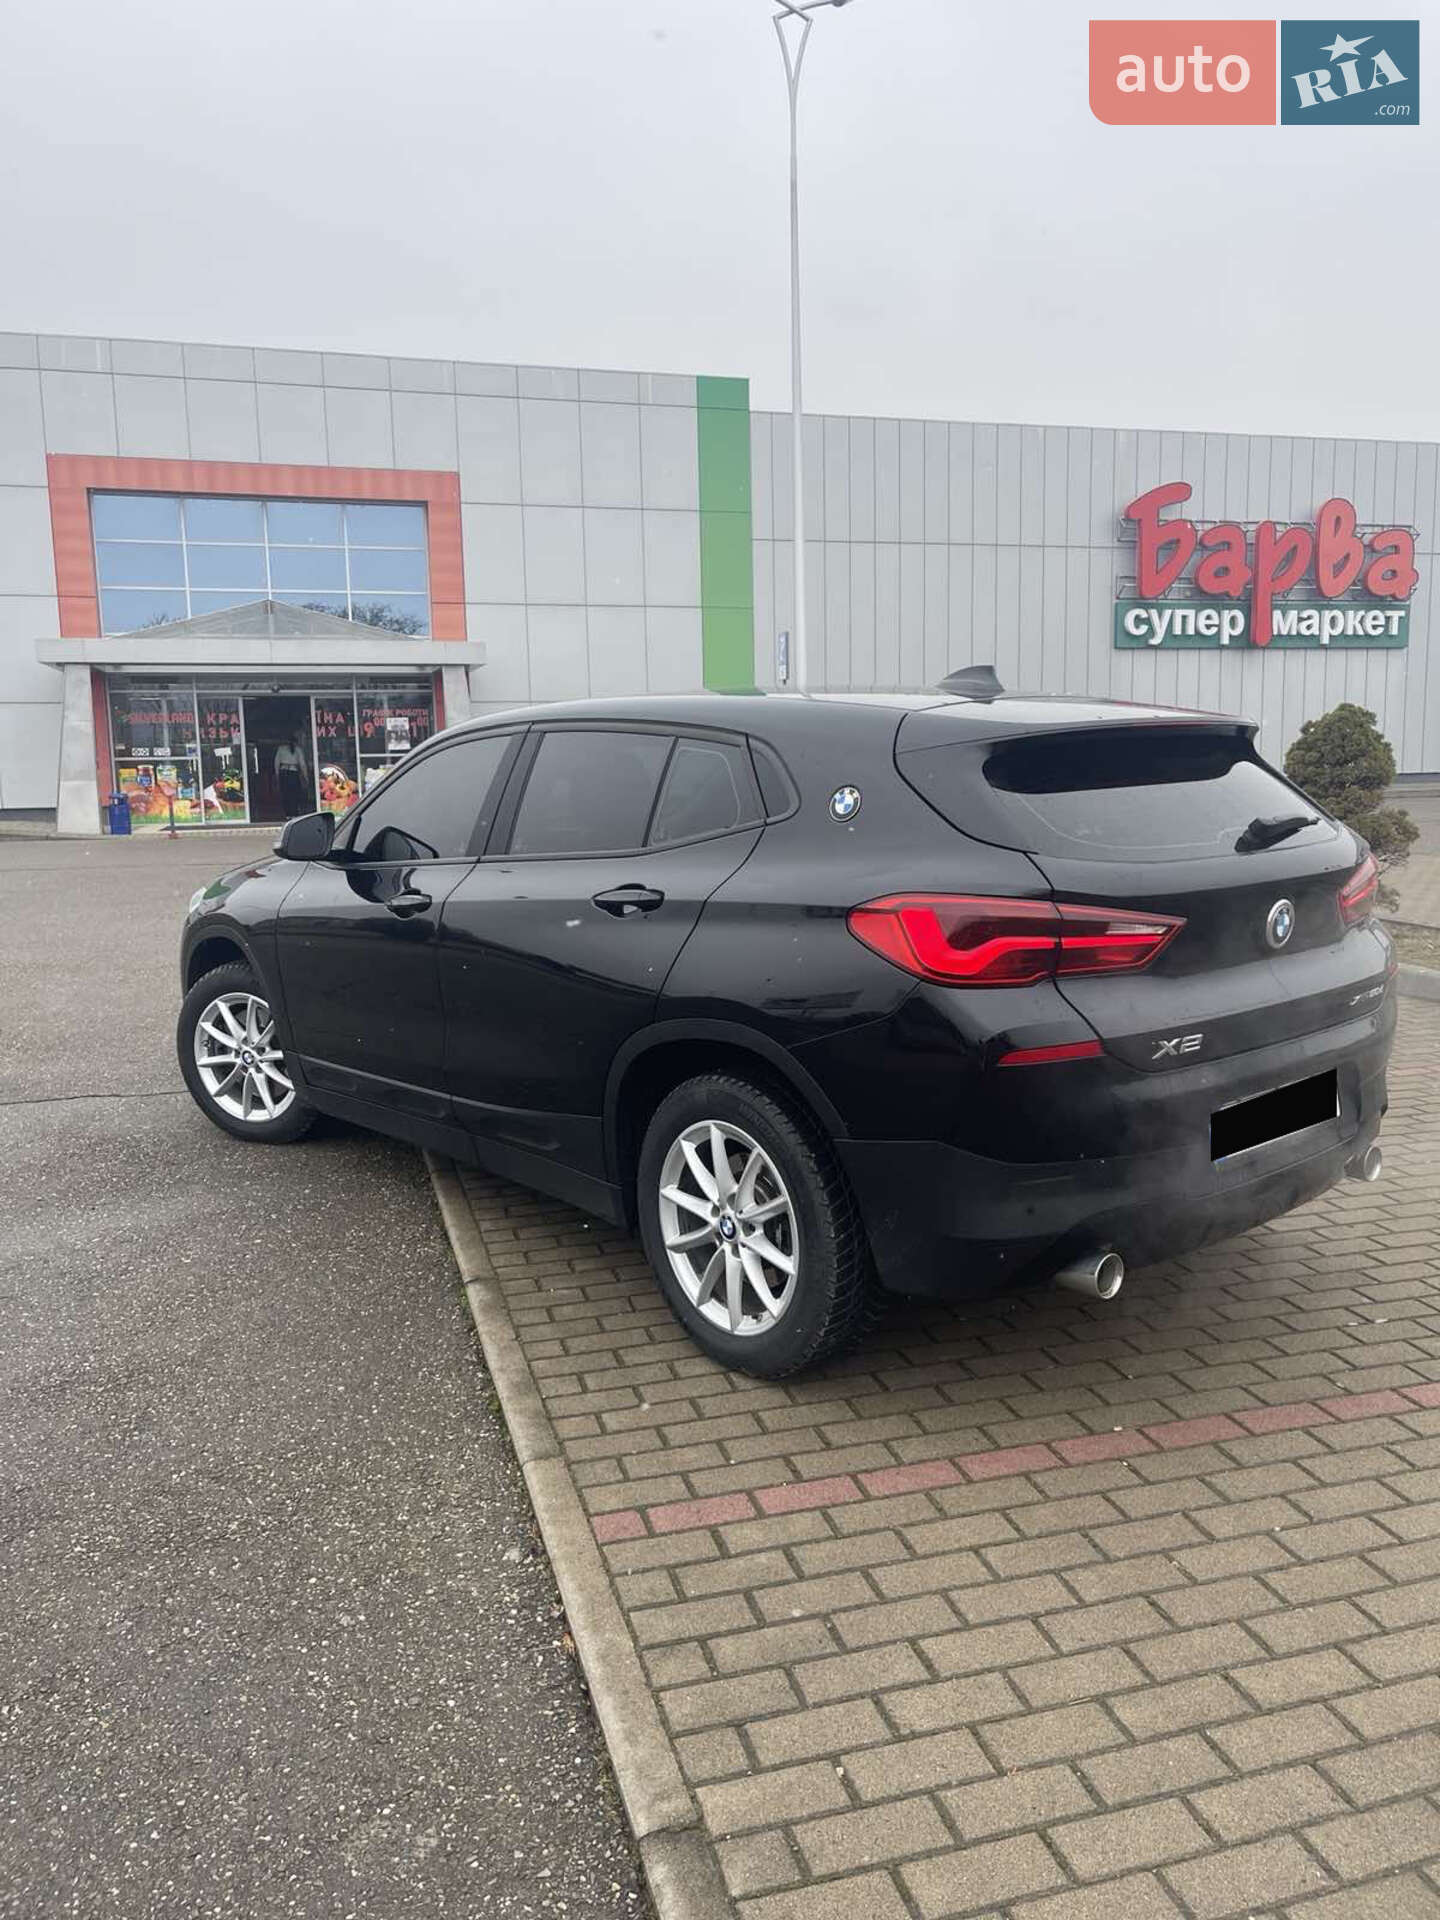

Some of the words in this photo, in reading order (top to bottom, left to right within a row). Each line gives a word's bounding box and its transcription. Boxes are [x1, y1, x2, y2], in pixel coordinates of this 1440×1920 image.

[1124, 481, 1419, 647] Барва
[1124, 607, 1246, 645] супер
[1272, 608, 1406, 645] маркет
[1152, 1033, 1203, 1060] X2
